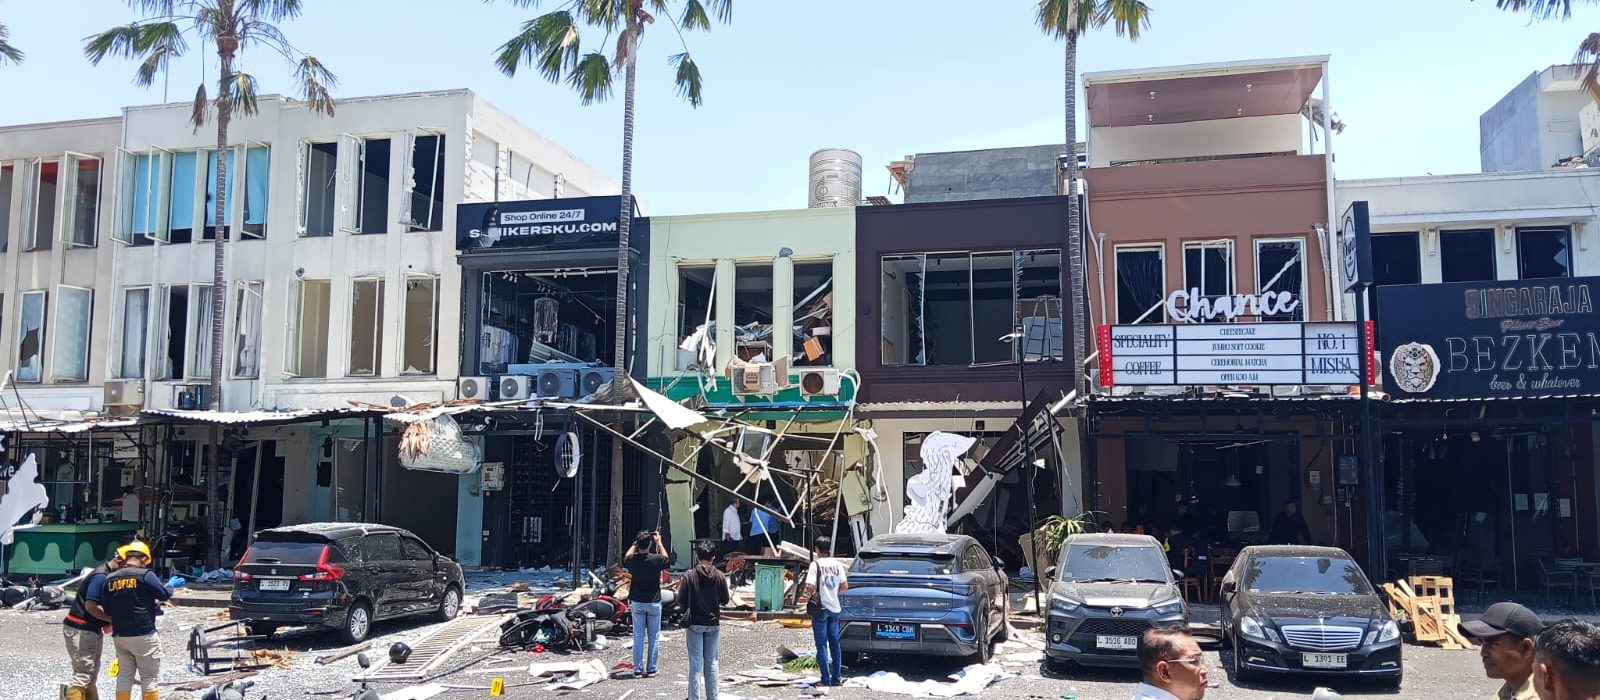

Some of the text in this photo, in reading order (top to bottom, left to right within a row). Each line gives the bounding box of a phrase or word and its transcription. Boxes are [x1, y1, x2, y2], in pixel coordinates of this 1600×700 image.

[504, 210, 583, 222] Shop Online 24/7
[469, 222, 617, 238] SIKERSKU.COM
[1167, 286, 1299, 322] Chance
[1465, 285, 1593, 320] SINGARAJA
[1219, 327, 1257, 336] CHEESECAKE
[1113, 334, 1170, 348] SPECIALITY
[1212, 343, 1266, 352] JUMBO SOFT COOKIE
[1317, 333, 1346, 350] NO. 1
[1125, 361, 1162, 375] COFFEE
[1311, 356, 1353, 374] MISUA
[1220, 373, 1235, 381] OPEN
[1516, 373, 1527, 390] &
[1531, 372, 1581, 389] whatever
[108, 577, 137, 592] LABFOR
[877, 624, 882, 632] L
[1303, 655, 1309, 663] L
[1336, 655, 1345, 664] EE
